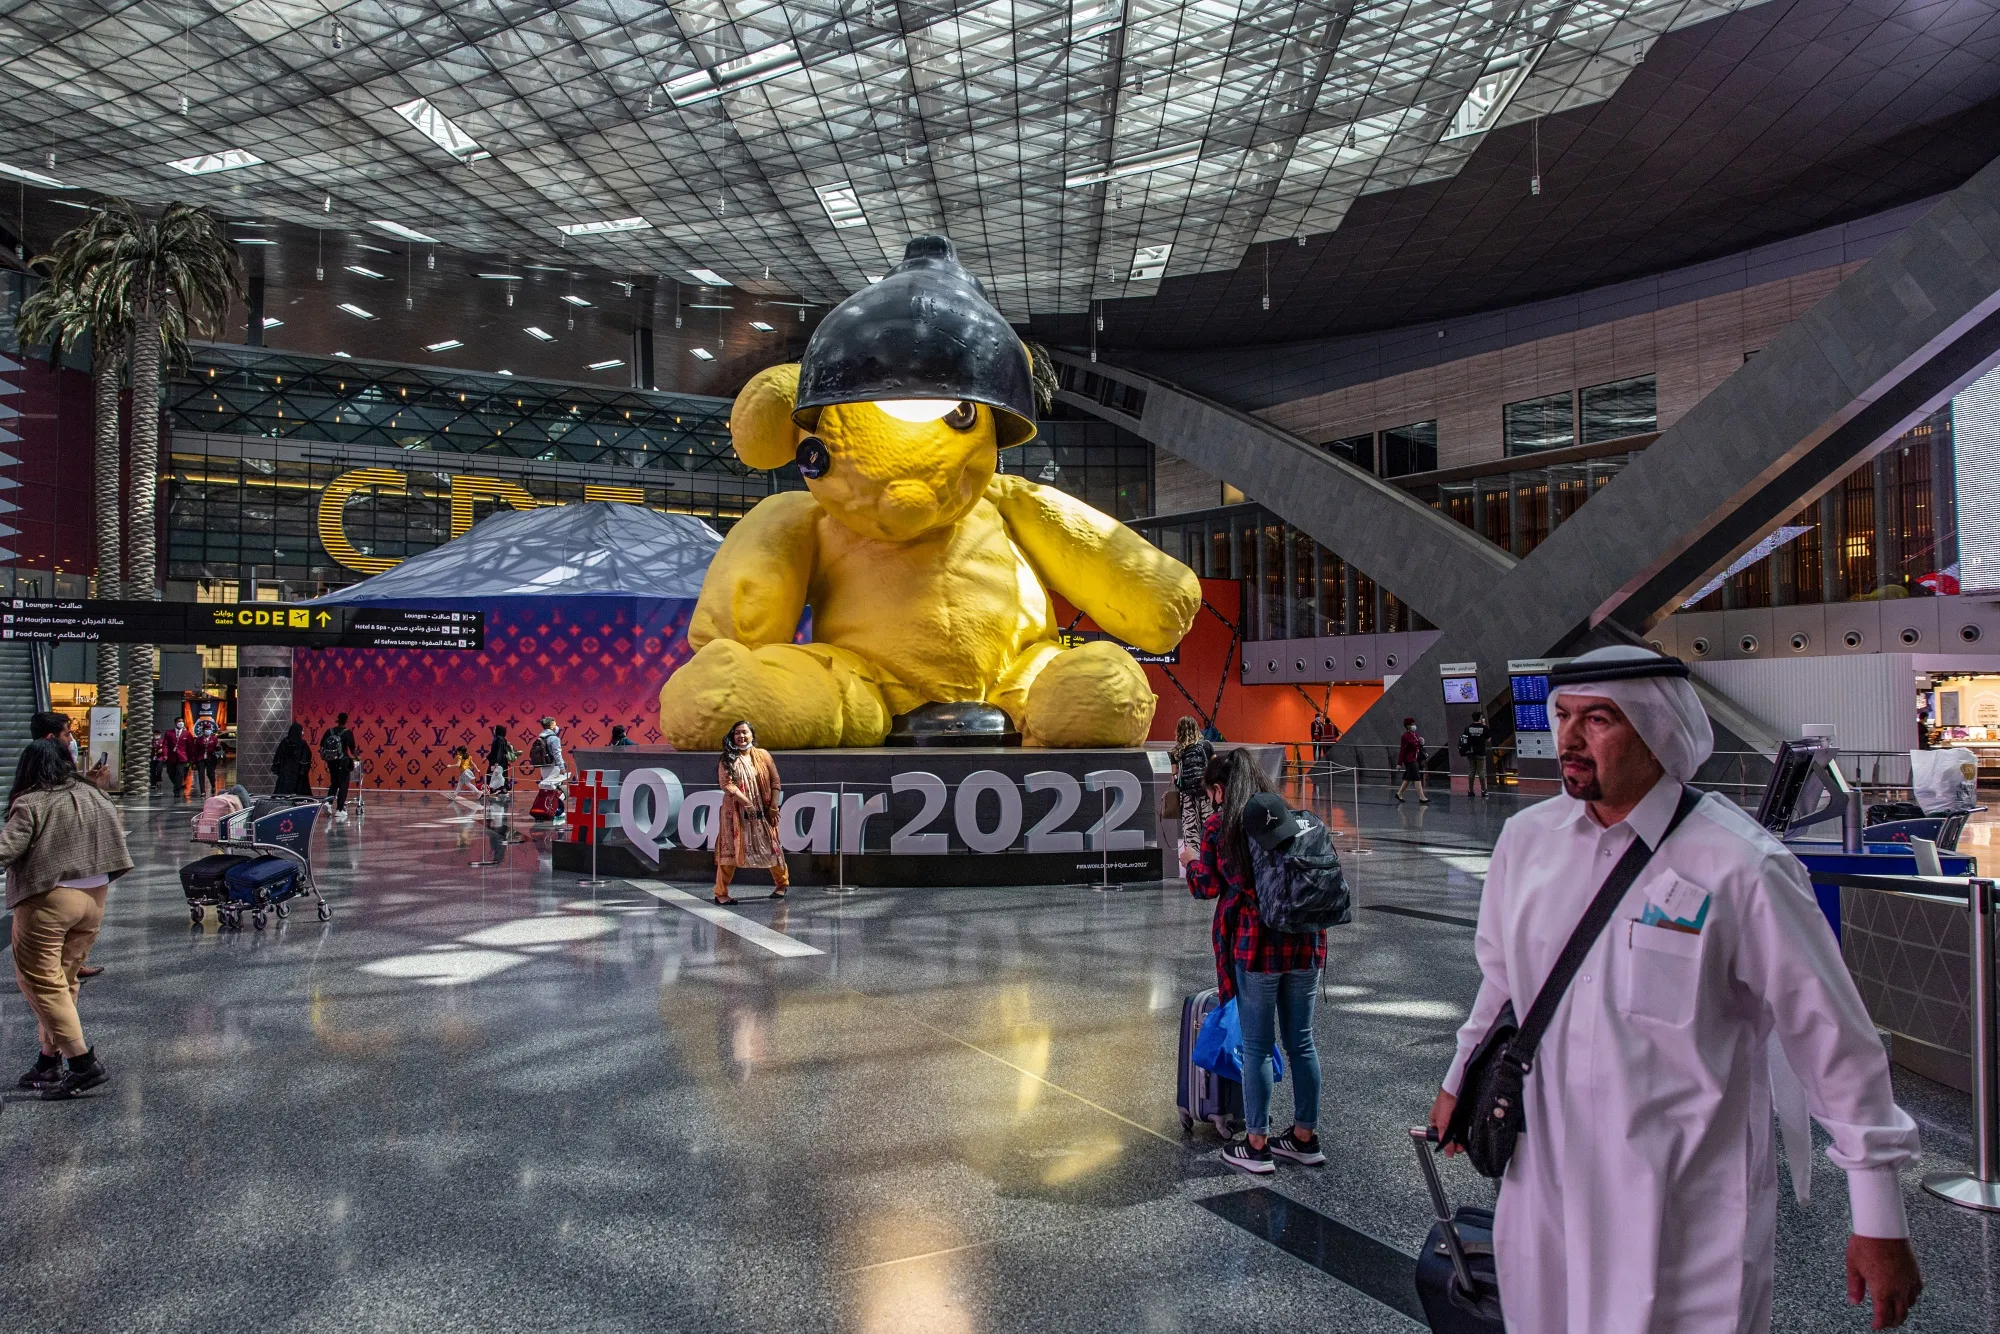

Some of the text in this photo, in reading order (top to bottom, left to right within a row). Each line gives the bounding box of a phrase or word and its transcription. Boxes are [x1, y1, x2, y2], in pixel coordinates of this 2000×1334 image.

[24, 617, 51, 625] Mourjan
[82, 618, 106, 626] المرجان
[238, 610, 285, 626] CDE
